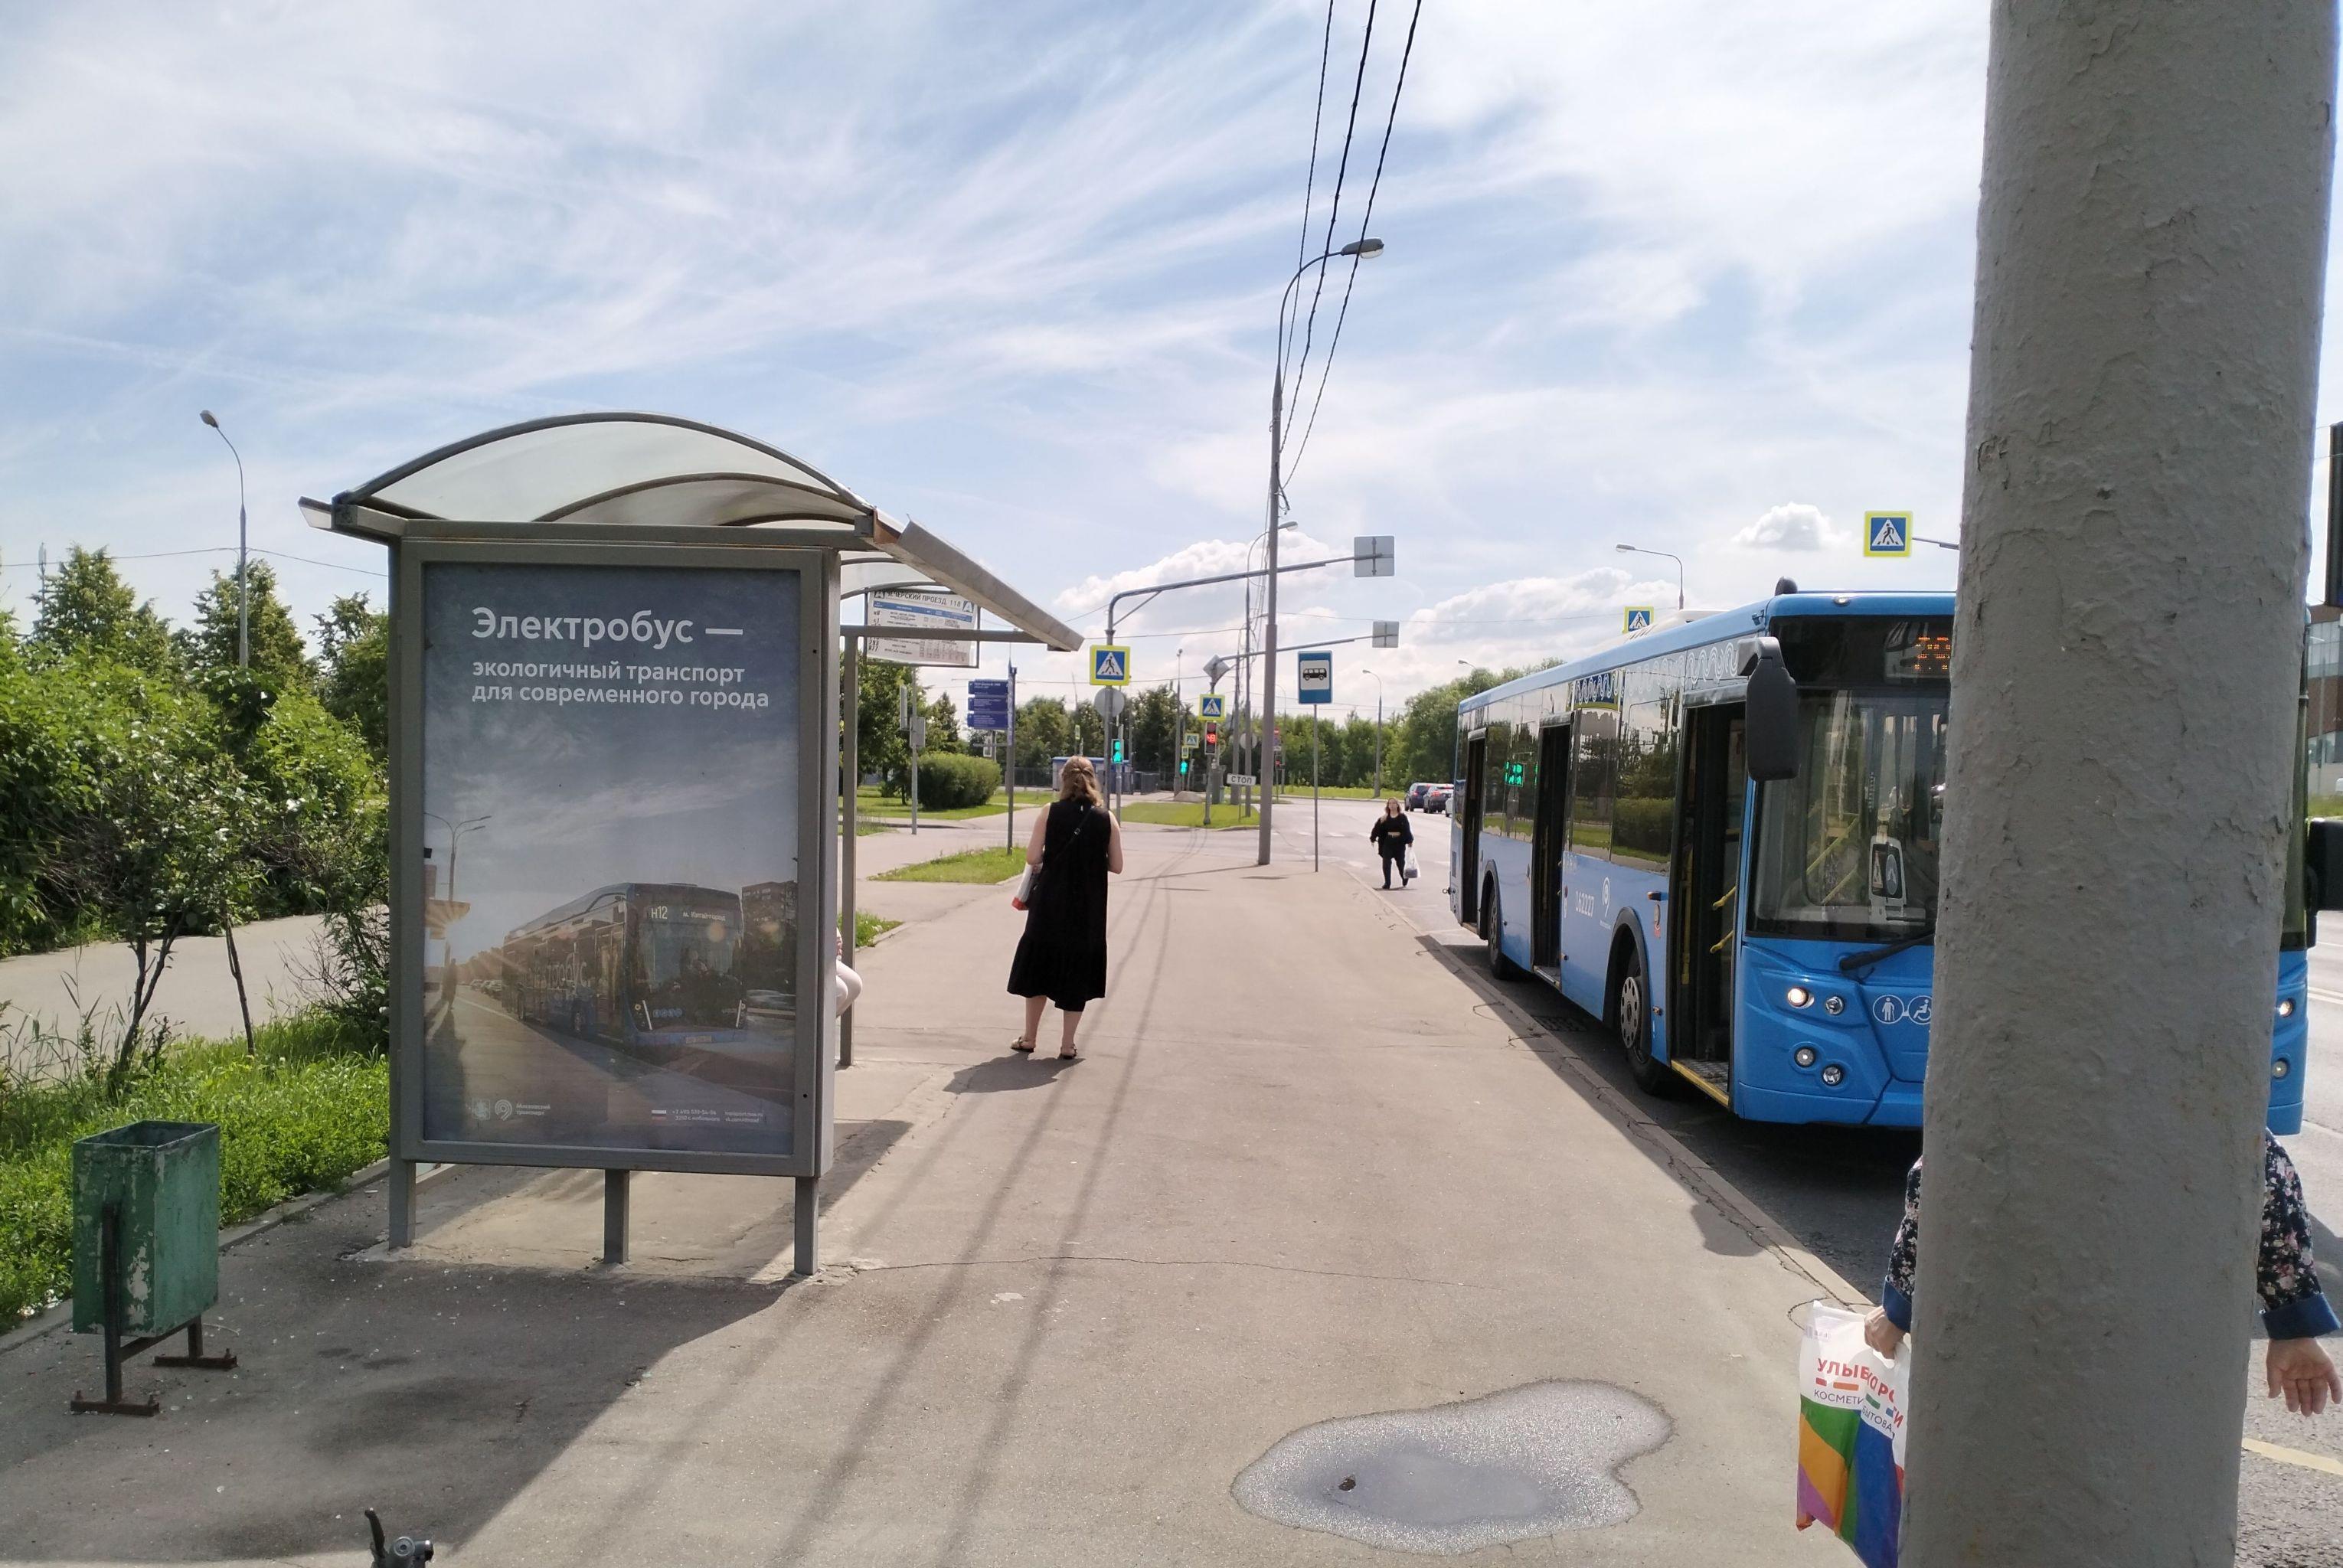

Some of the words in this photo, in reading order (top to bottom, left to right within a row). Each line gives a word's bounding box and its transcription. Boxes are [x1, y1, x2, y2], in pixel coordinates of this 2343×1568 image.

[472, 606, 693, 649] Электробус
[472, 661, 621, 681] экологичный
[626, 665, 744, 686] транспорт
[472, 685, 513, 702] для
[519, 685, 682, 706] современного
[691, 691, 769, 709] города
